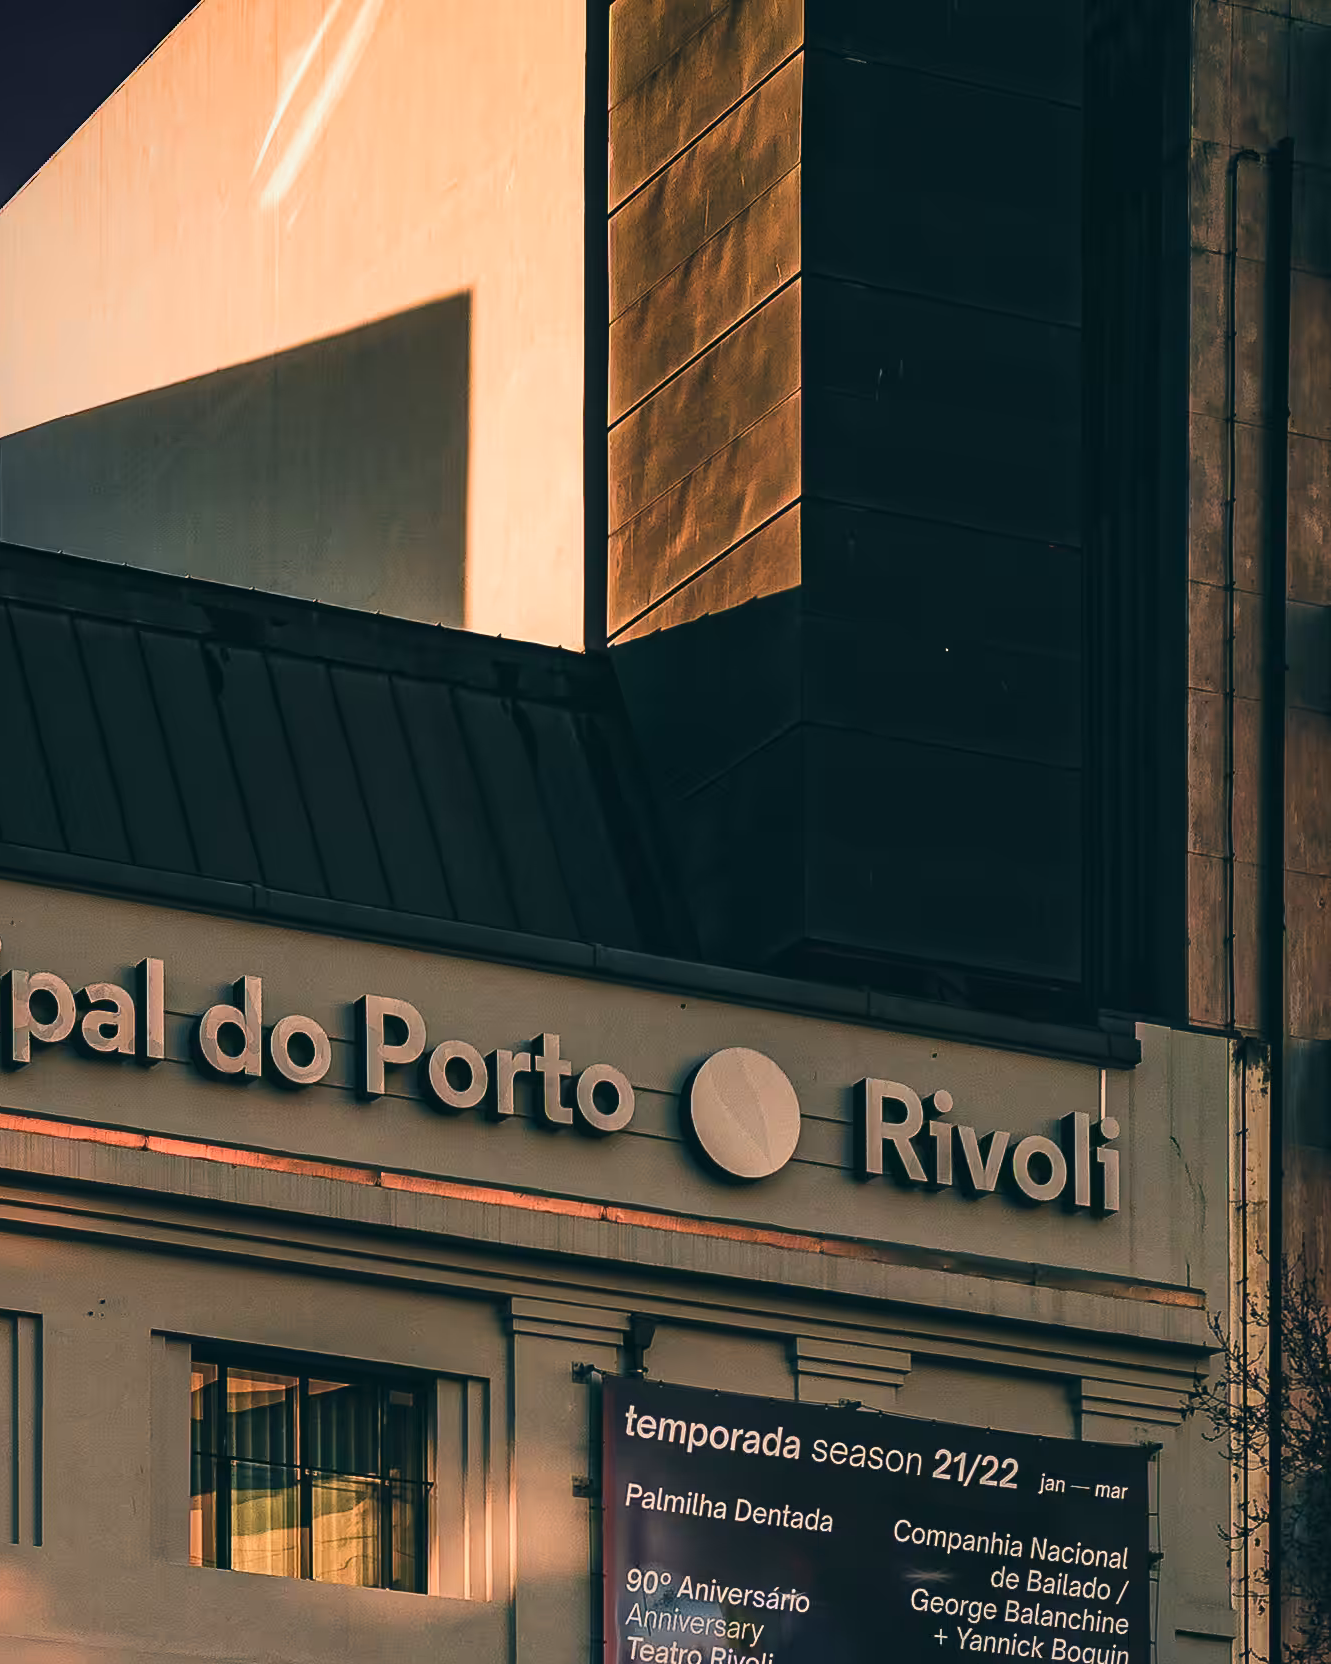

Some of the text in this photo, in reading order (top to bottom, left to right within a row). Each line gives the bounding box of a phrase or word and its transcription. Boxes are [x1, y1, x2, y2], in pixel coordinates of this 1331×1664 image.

[199, 976, 331, 1086] do
[356, 993, 635, 1134] Porto
[854, 1077, 1120, 1215] Rivoli
[624, 1404, 1019, 1489] temporada season 21/22
[624, 1482, 834, 1533] Palmilha Dentada
[1037, 1472, 1129, 1500] jan mar
[893, 1519, 1129, 1570] Companhia Nacional
[676, 1575, 810, 1613] Aniversário
[990, 1565, 1130, 1605] de Bailado /
[624, 1602, 765, 1648] Anniversary
[910, 1587, 1130, 1635] George Balanchine
[933, 1628, 949, 1646] +
[956, 1625, 1045, 1659] Yannick
